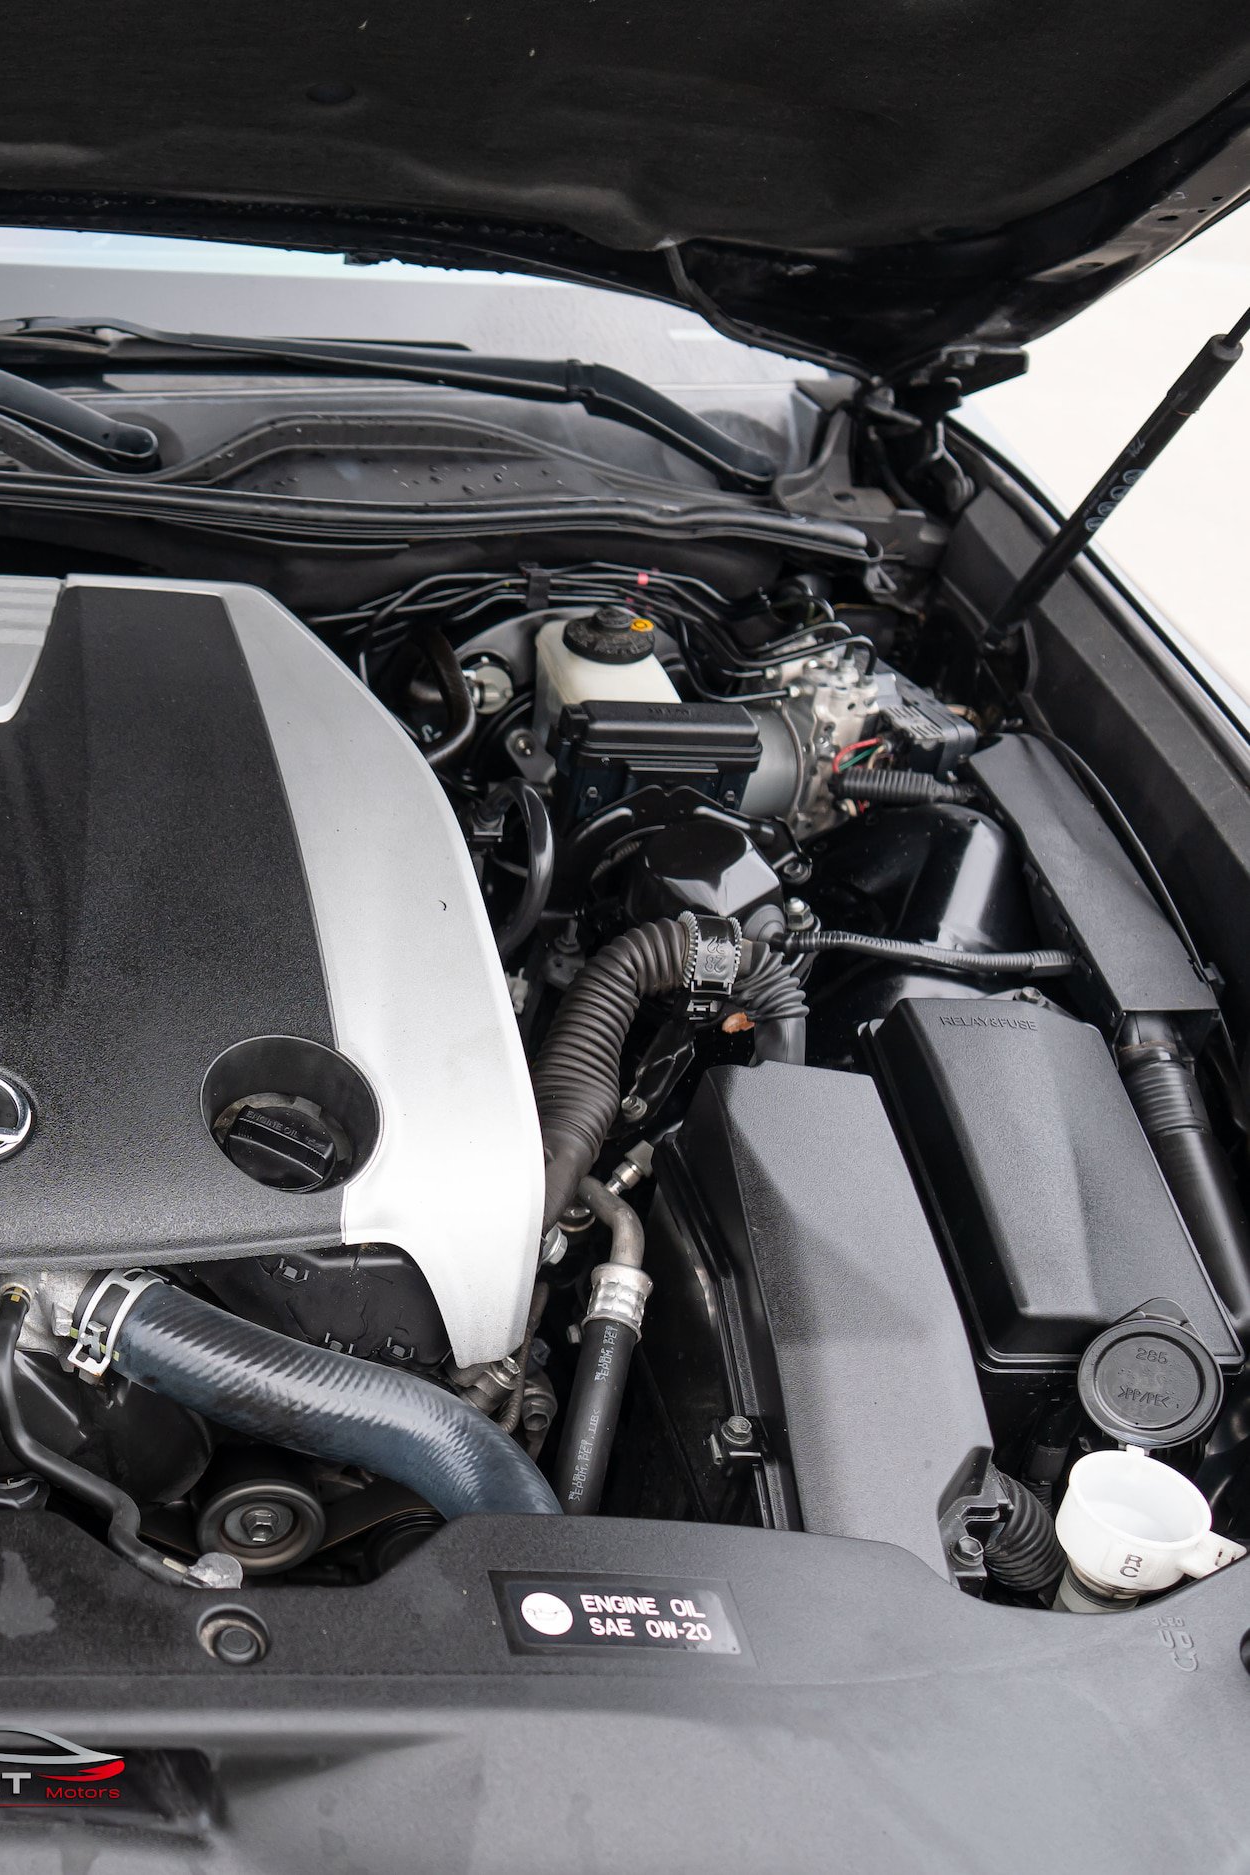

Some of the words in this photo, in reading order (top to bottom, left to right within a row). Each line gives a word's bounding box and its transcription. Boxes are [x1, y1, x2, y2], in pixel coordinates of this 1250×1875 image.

[246, 1110, 283, 1131] ENGINE
[283, 1125, 300, 1140] OIL
[579, 1593, 660, 1616] ENGINE
[669, 1598, 707, 1619] OIL
[588, 1617, 636, 1637] SAE
[644, 1619, 713, 1642] 0W-20
